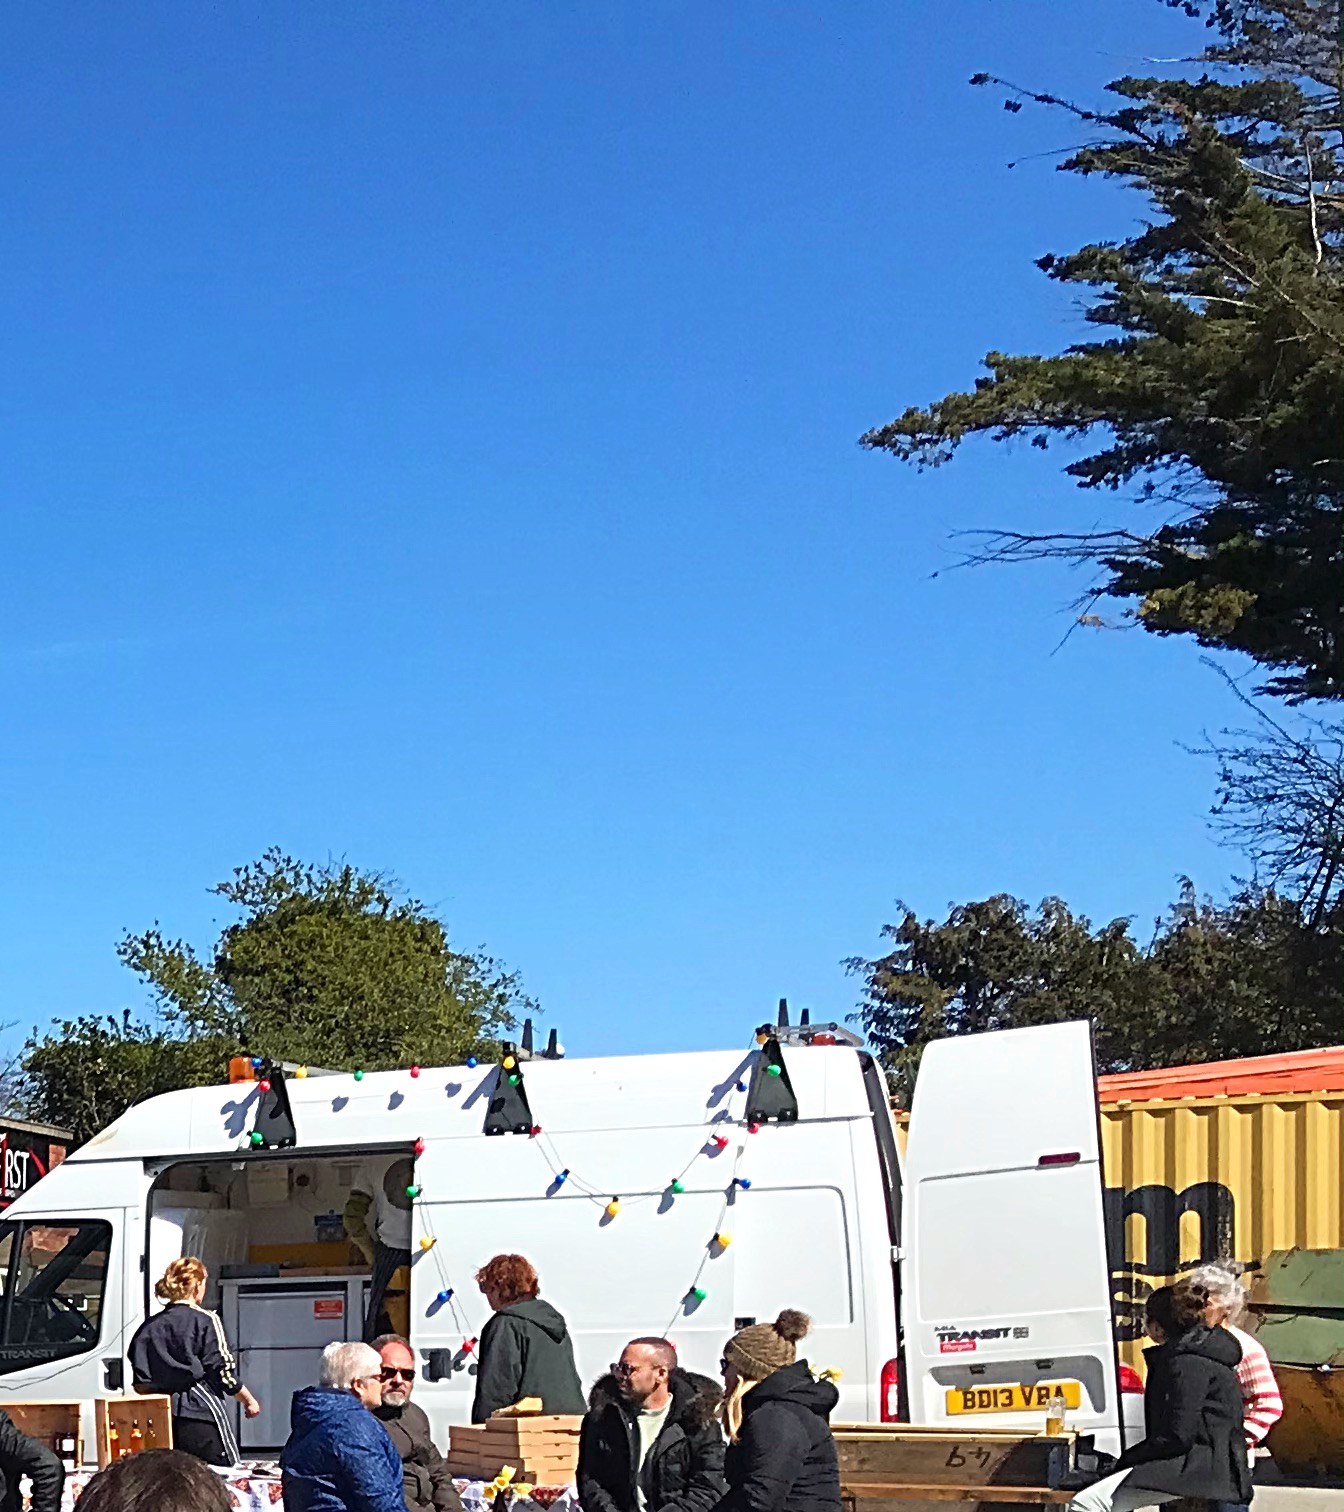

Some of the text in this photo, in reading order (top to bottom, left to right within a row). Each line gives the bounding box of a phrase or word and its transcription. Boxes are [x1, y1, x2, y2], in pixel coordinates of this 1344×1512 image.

[936, 1327, 1012, 1343] TRANSIT
[0, 1348, 57, 1360] TRANSIT
[962, 1388, 1014, 1410] BD13
